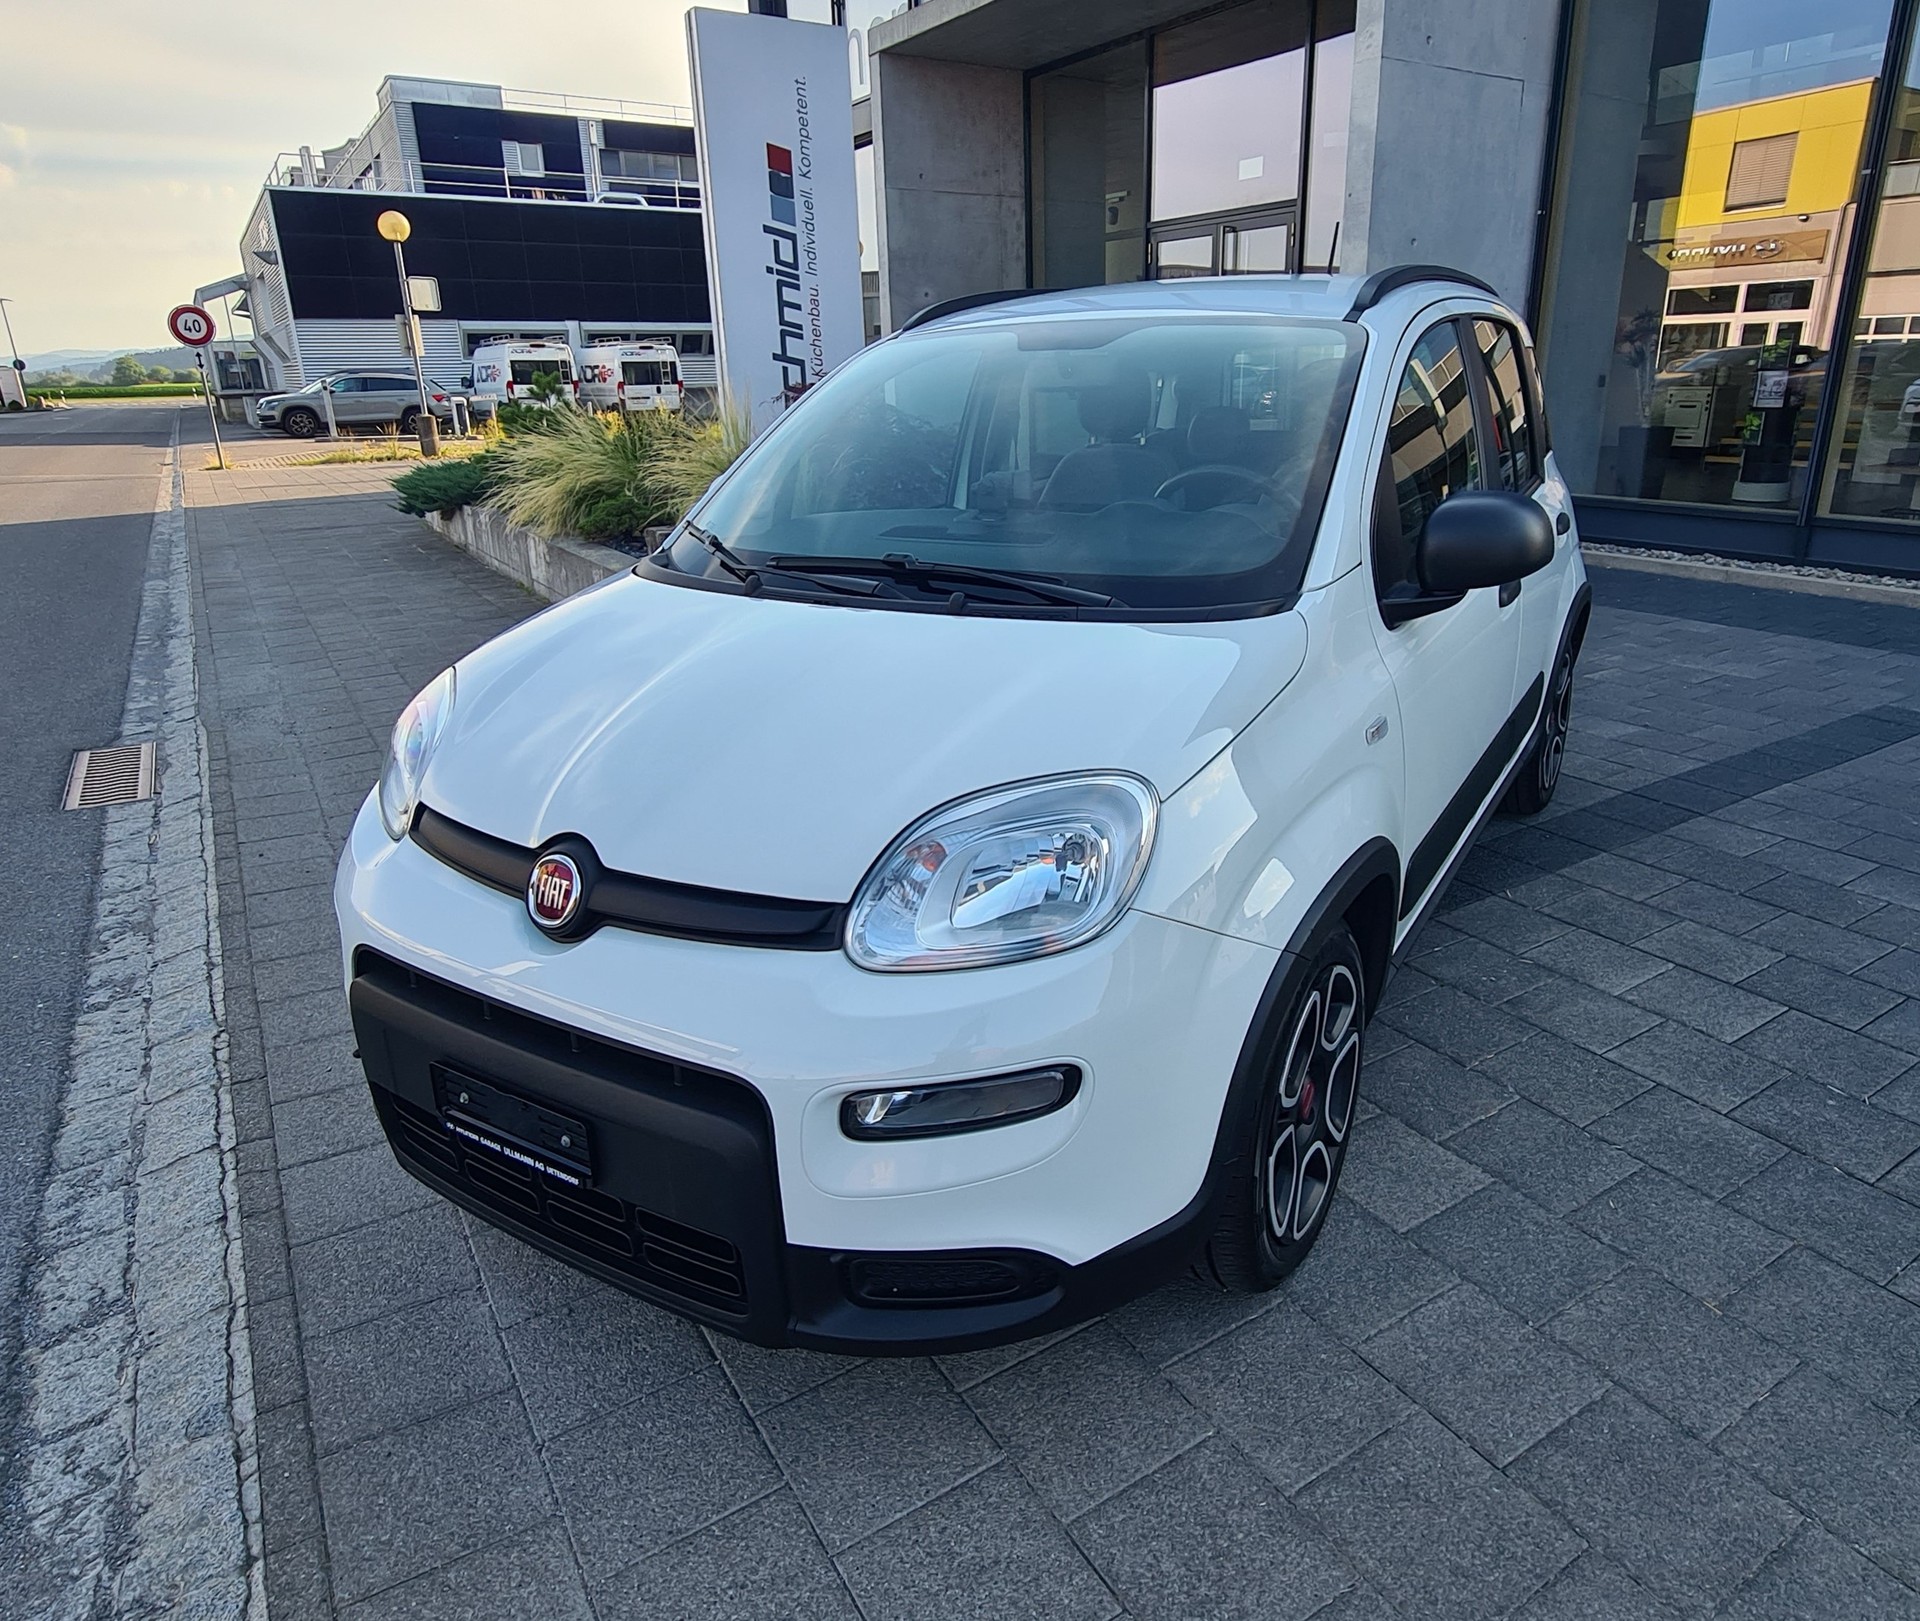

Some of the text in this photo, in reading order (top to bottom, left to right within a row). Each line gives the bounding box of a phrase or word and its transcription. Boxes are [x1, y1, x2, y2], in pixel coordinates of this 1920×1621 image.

[795, 76, 824, 377] Küchenbau. Individuell. Kompetent.
[184, 319, 202, 333] 40
[763, 224, 807, 409] chmid
[537, 874, 570, 910] FIAT
